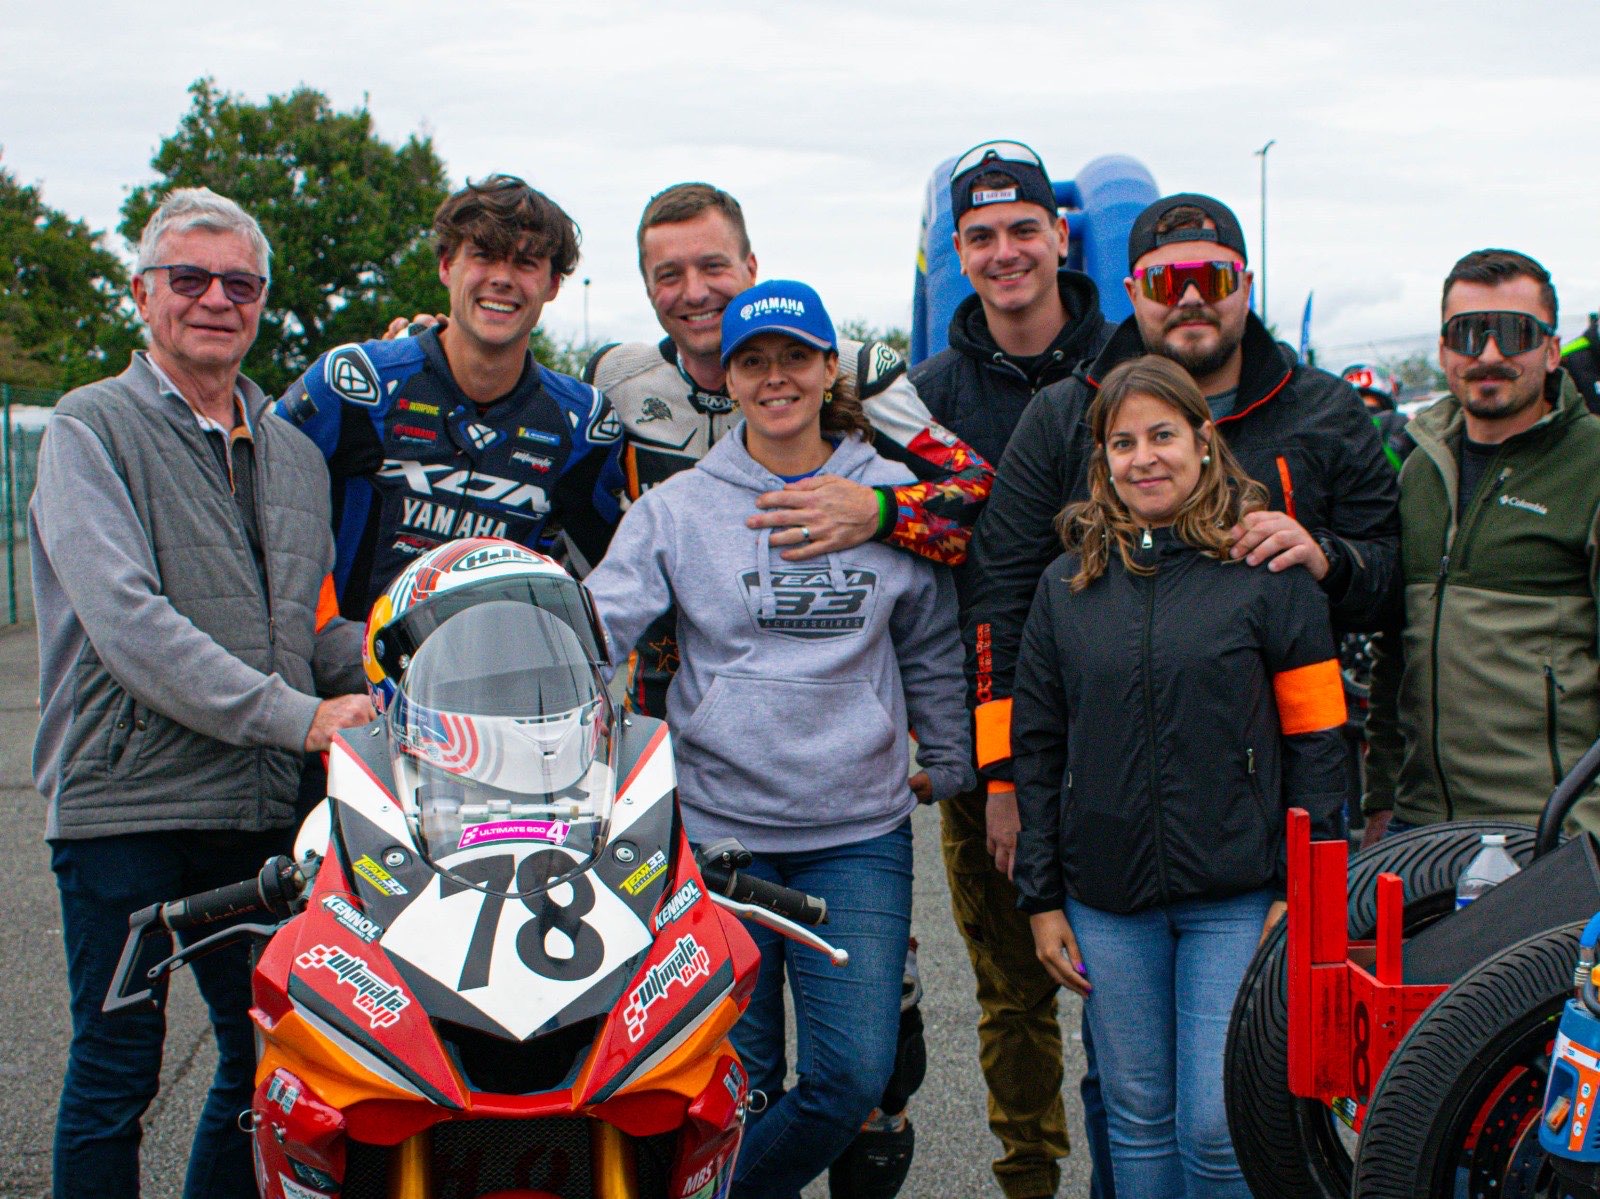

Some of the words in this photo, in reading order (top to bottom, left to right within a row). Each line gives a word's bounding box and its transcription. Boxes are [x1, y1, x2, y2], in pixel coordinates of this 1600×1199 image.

[753, 297, 805, 313] YAMAHA
[403, 498, 508, 538] YAMAHA
[466, 548, 533, 569] HJC
[768, 572, 863, 586] EAM
[479, 826, 525, 836] ULTIMATE
[546, 820, 566, 844] 4
[619, 862, 651, 895] TEAM
[646, 850, 666, 870] 33
[322, 895, 380, 938] KENNOL
[440, 848, 605, 991] 78
[655, 881, 700, 930] KENNOL
